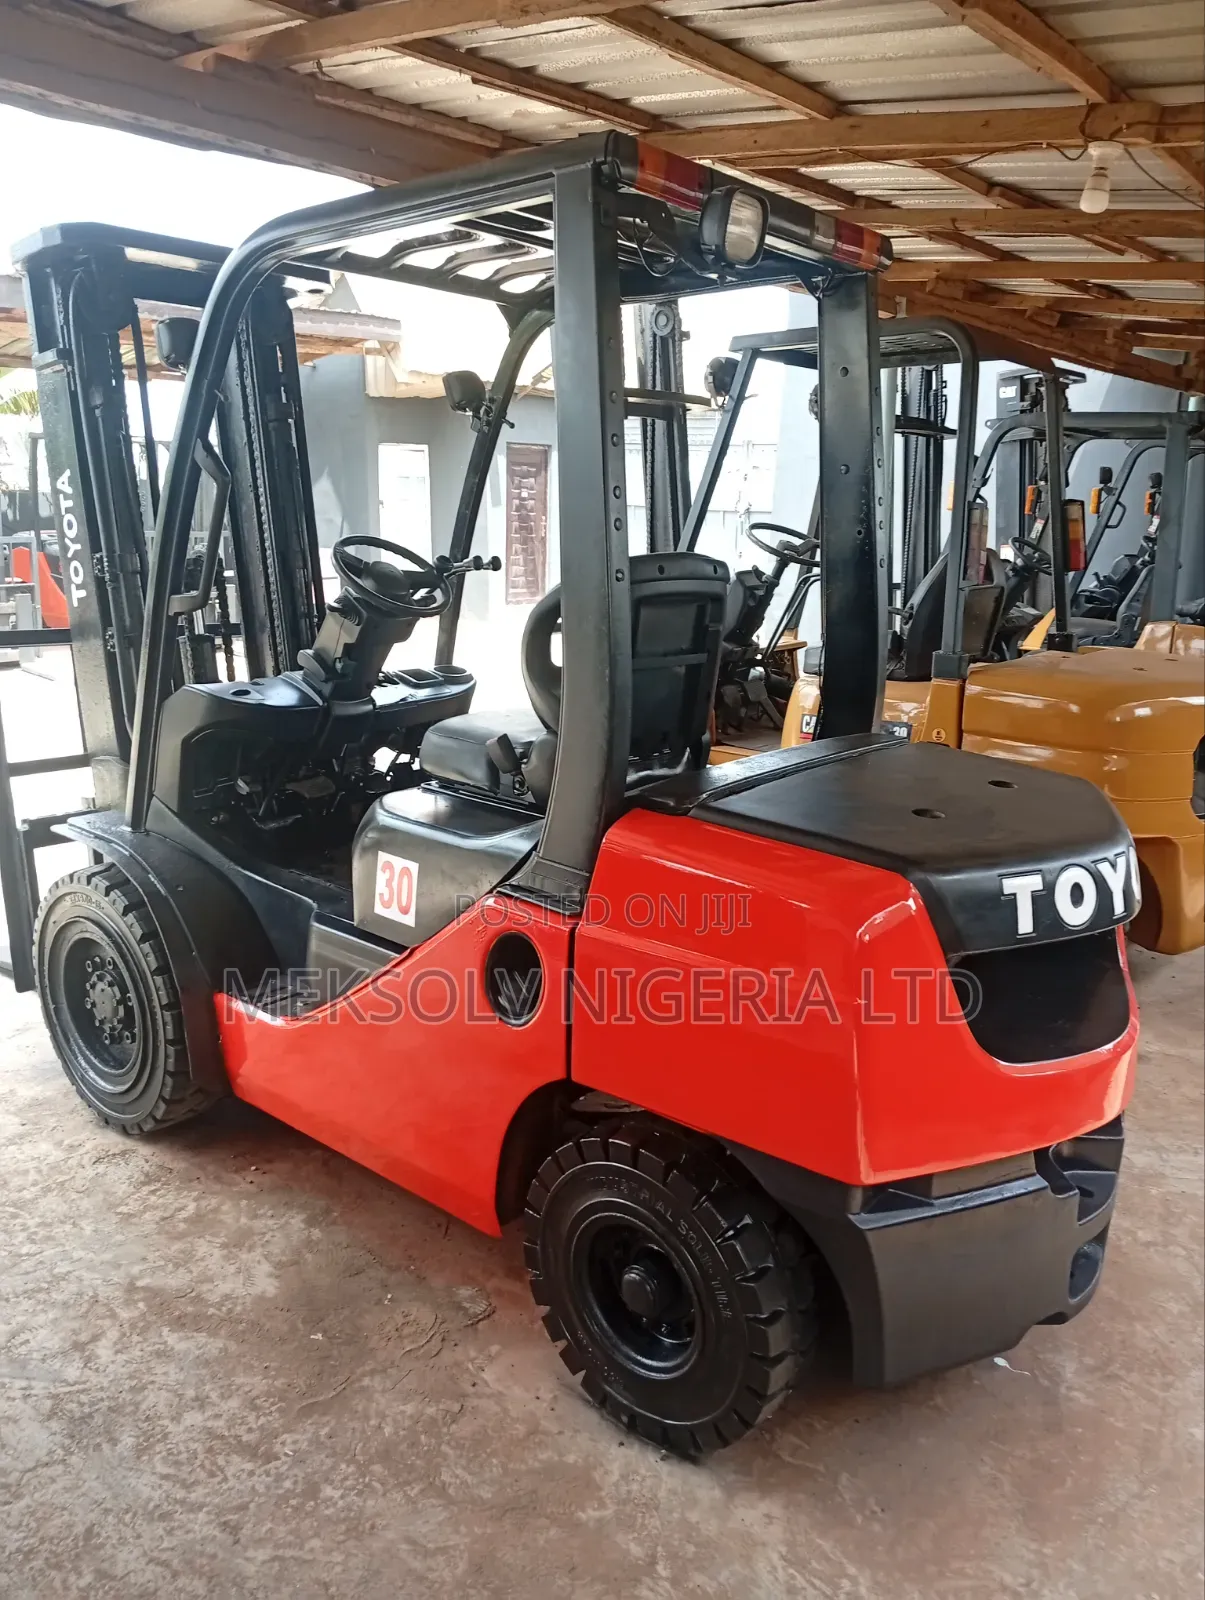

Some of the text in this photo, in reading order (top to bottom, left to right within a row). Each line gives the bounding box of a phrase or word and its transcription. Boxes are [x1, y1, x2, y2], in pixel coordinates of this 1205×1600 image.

[57, 468, 87, 607] TOYOTA
[802, 714, 817, 732] CA
[378, 860, 413, 915] 30
